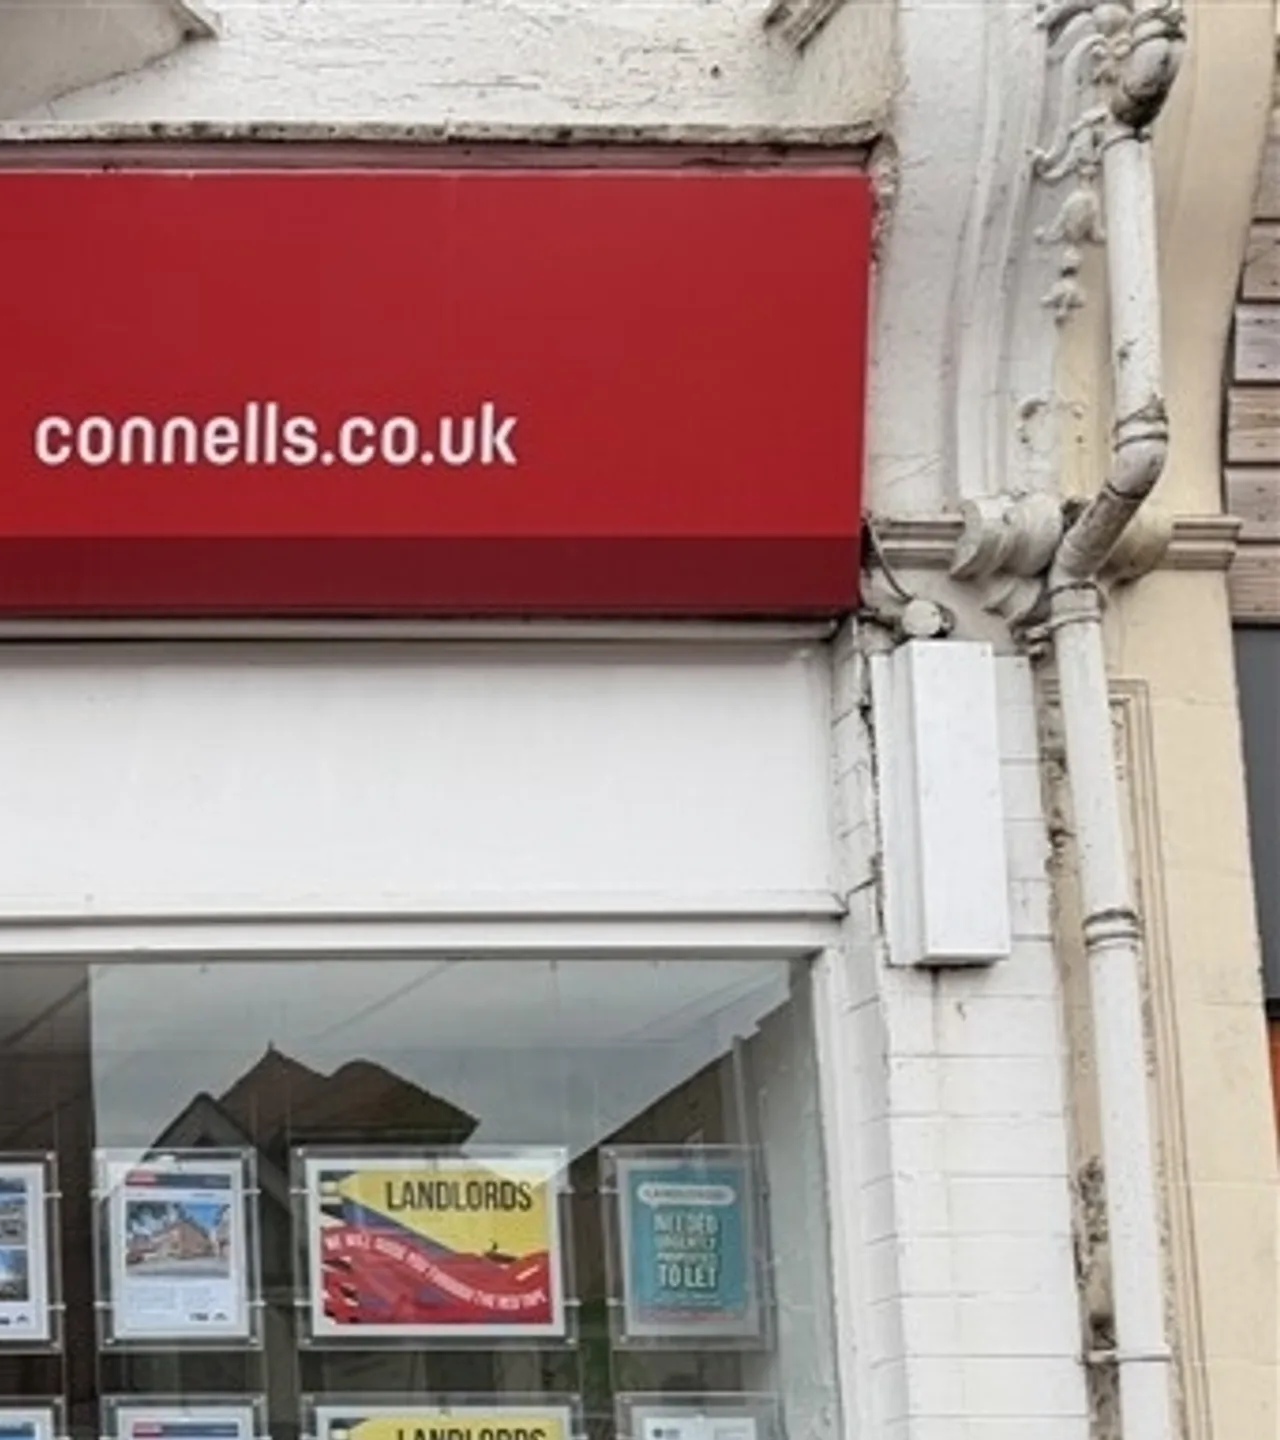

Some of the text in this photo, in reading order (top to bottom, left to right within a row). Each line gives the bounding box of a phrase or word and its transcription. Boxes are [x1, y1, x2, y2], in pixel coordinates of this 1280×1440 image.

[35, 401, 517, 464] connells.co.uk
[385, 1180, 532, 1212] LANDLORDS
[658, 1264, 681, 1288] TO
